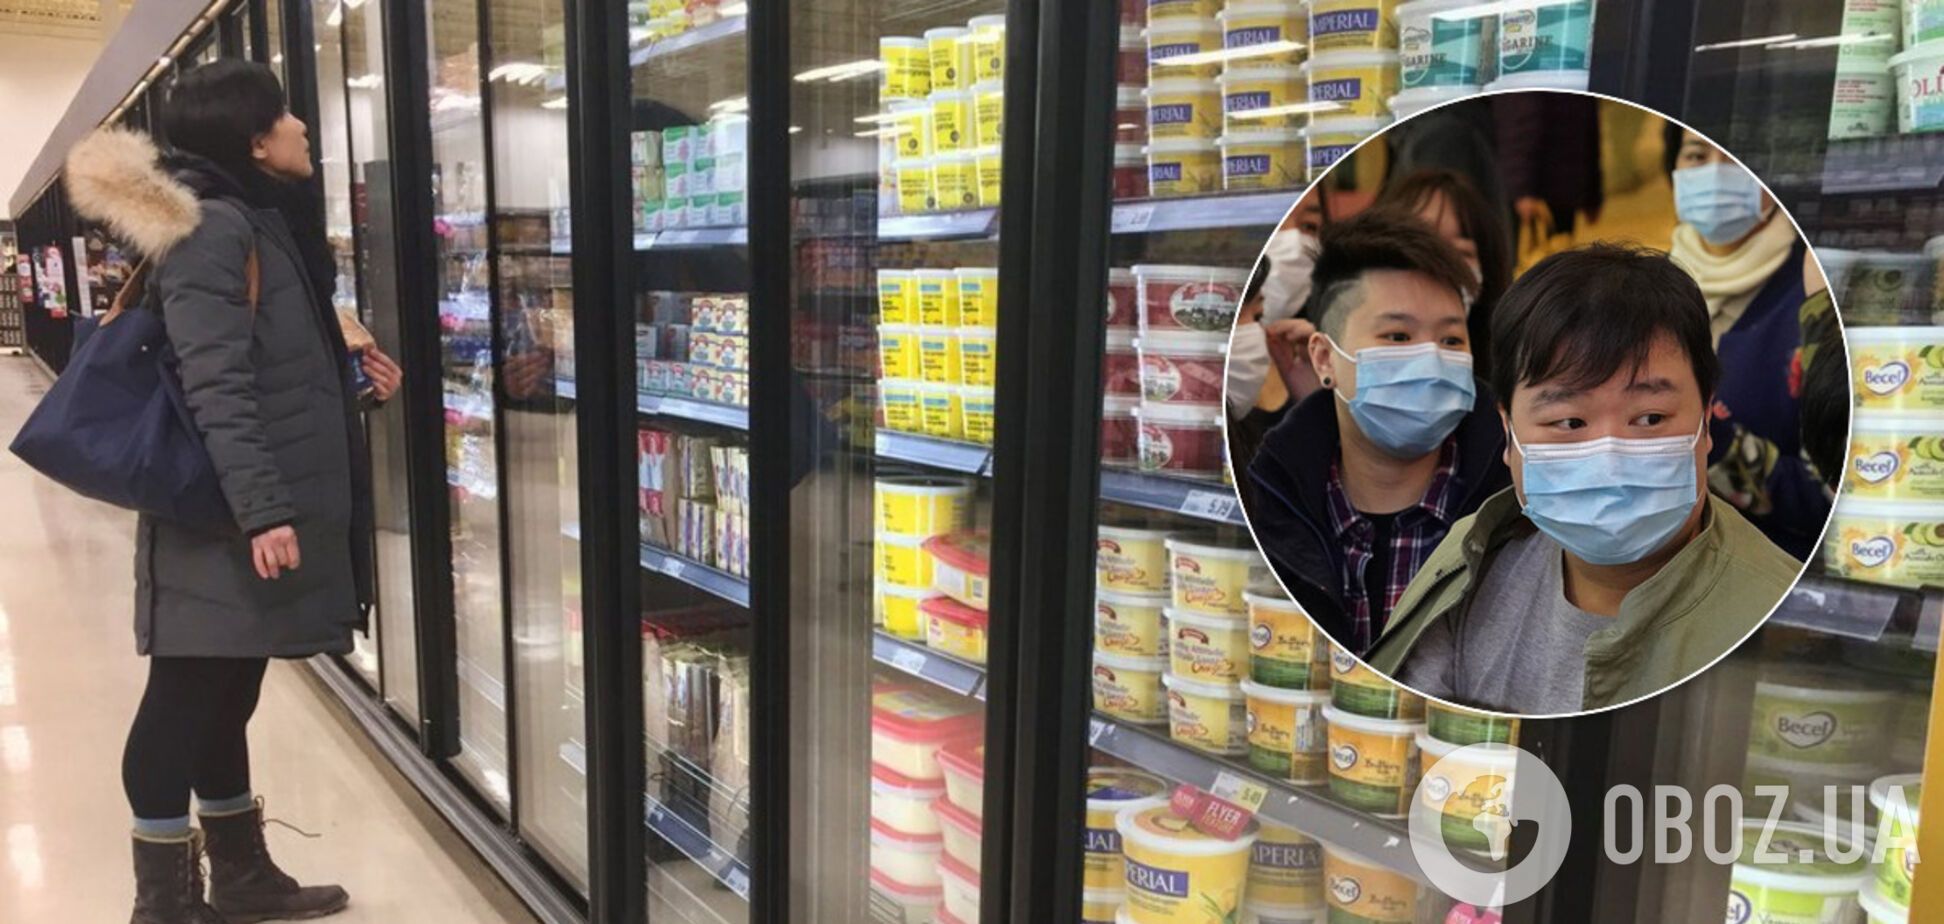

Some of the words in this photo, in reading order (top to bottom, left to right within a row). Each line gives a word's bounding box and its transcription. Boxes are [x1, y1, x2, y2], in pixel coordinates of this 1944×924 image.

[1865, 369, 1902, 385] Becel
[1855, 459, 1893, 473] Becel
[1852, 543, 1889, 557] Becel
[1777, 716, 1828, 738] Becel
[1206, 801, 1241, 825] FLYER
